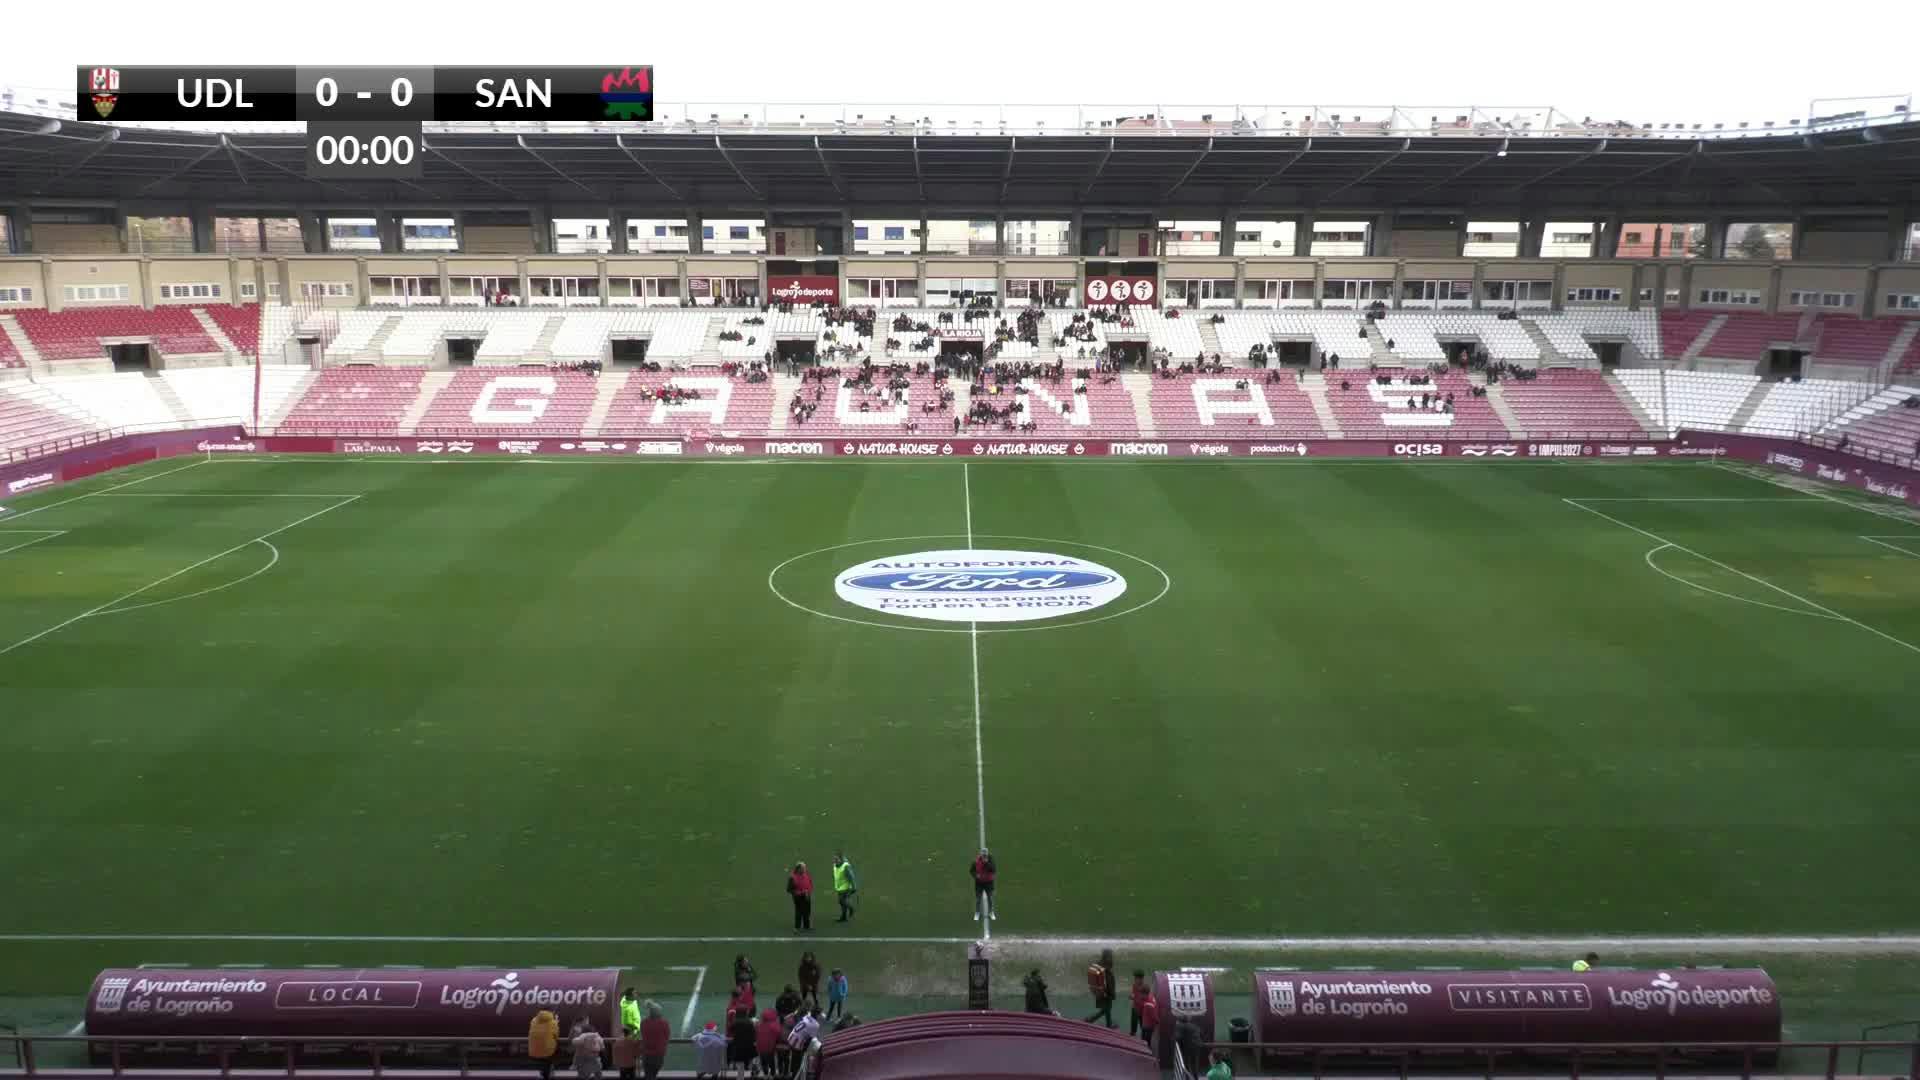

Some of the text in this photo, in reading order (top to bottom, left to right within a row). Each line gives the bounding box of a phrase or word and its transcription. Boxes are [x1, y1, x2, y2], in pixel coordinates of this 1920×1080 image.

[765, 442, 823, 455] macron
[1111, 442, 1168, 455] macron
[871, 560, 1080, 569] AUTOFORMA
[890, 571, 1068, 590] Ford
[132, 977, 267, 995] Ayuntamiento
[308, 987, 383, 1001] LOCAL
[1300, 980, 1432, 998] Ayuntamiento
[1459, 989, 1585, 1004] VISITANTE
[127, 996, 234, 1016] de Logroño
[1302, 998, 1408, 1018] de Logroño
